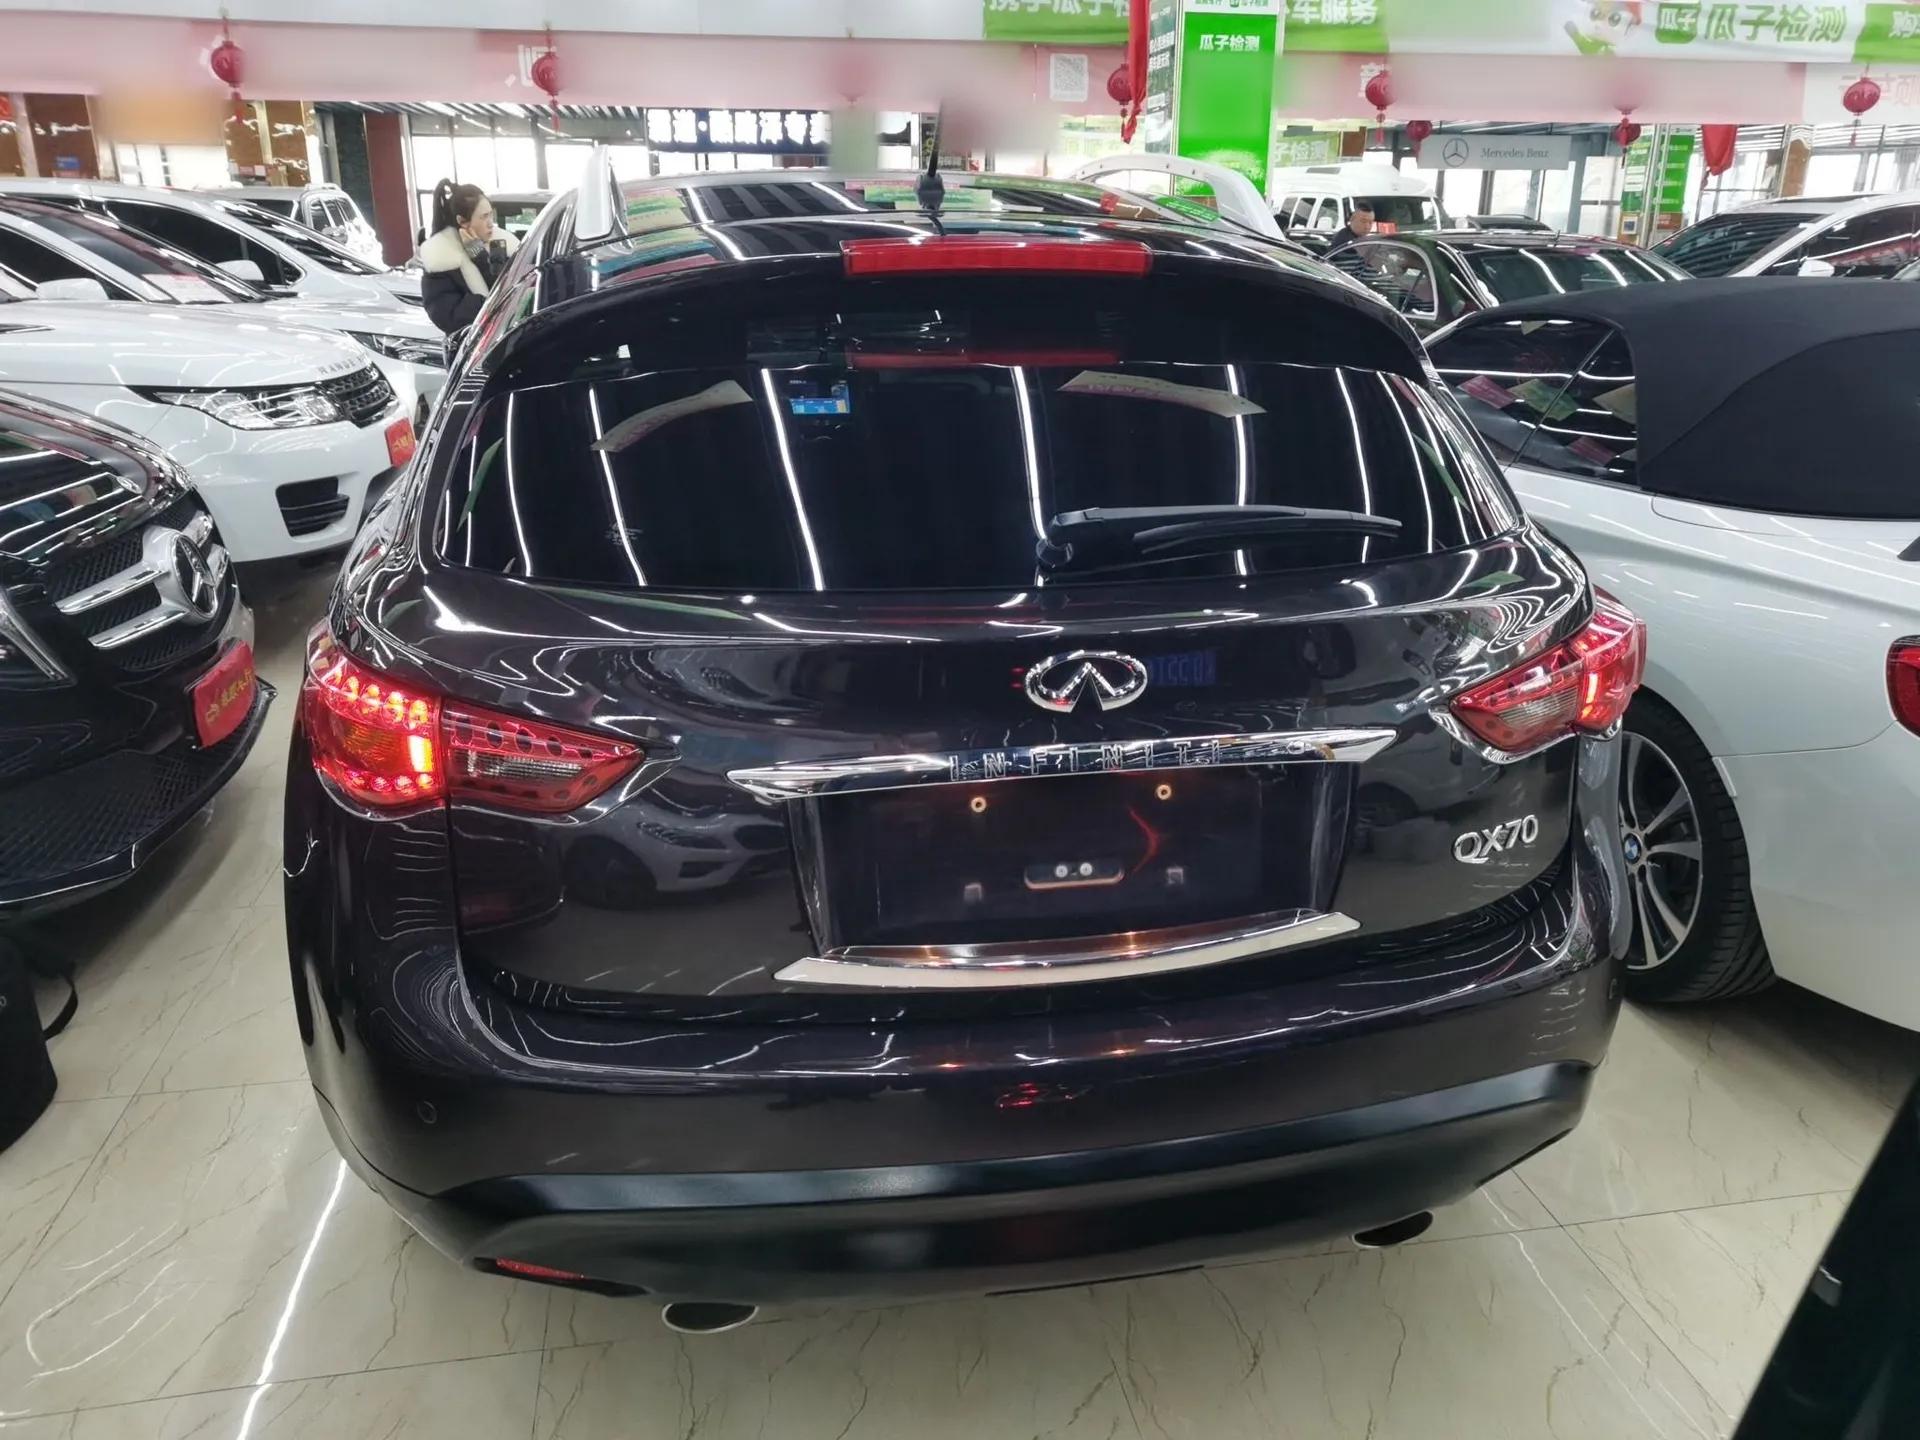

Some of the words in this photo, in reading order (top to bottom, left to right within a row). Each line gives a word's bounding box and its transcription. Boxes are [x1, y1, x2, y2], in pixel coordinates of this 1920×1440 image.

[1199, 33, 1260, 52] 瓜子检测
[1703, 4, 1848, 43] 瓜子检测
[949, 738, 1220, 782] INFINITI
[1454, 814, 1539, 864] QX70
